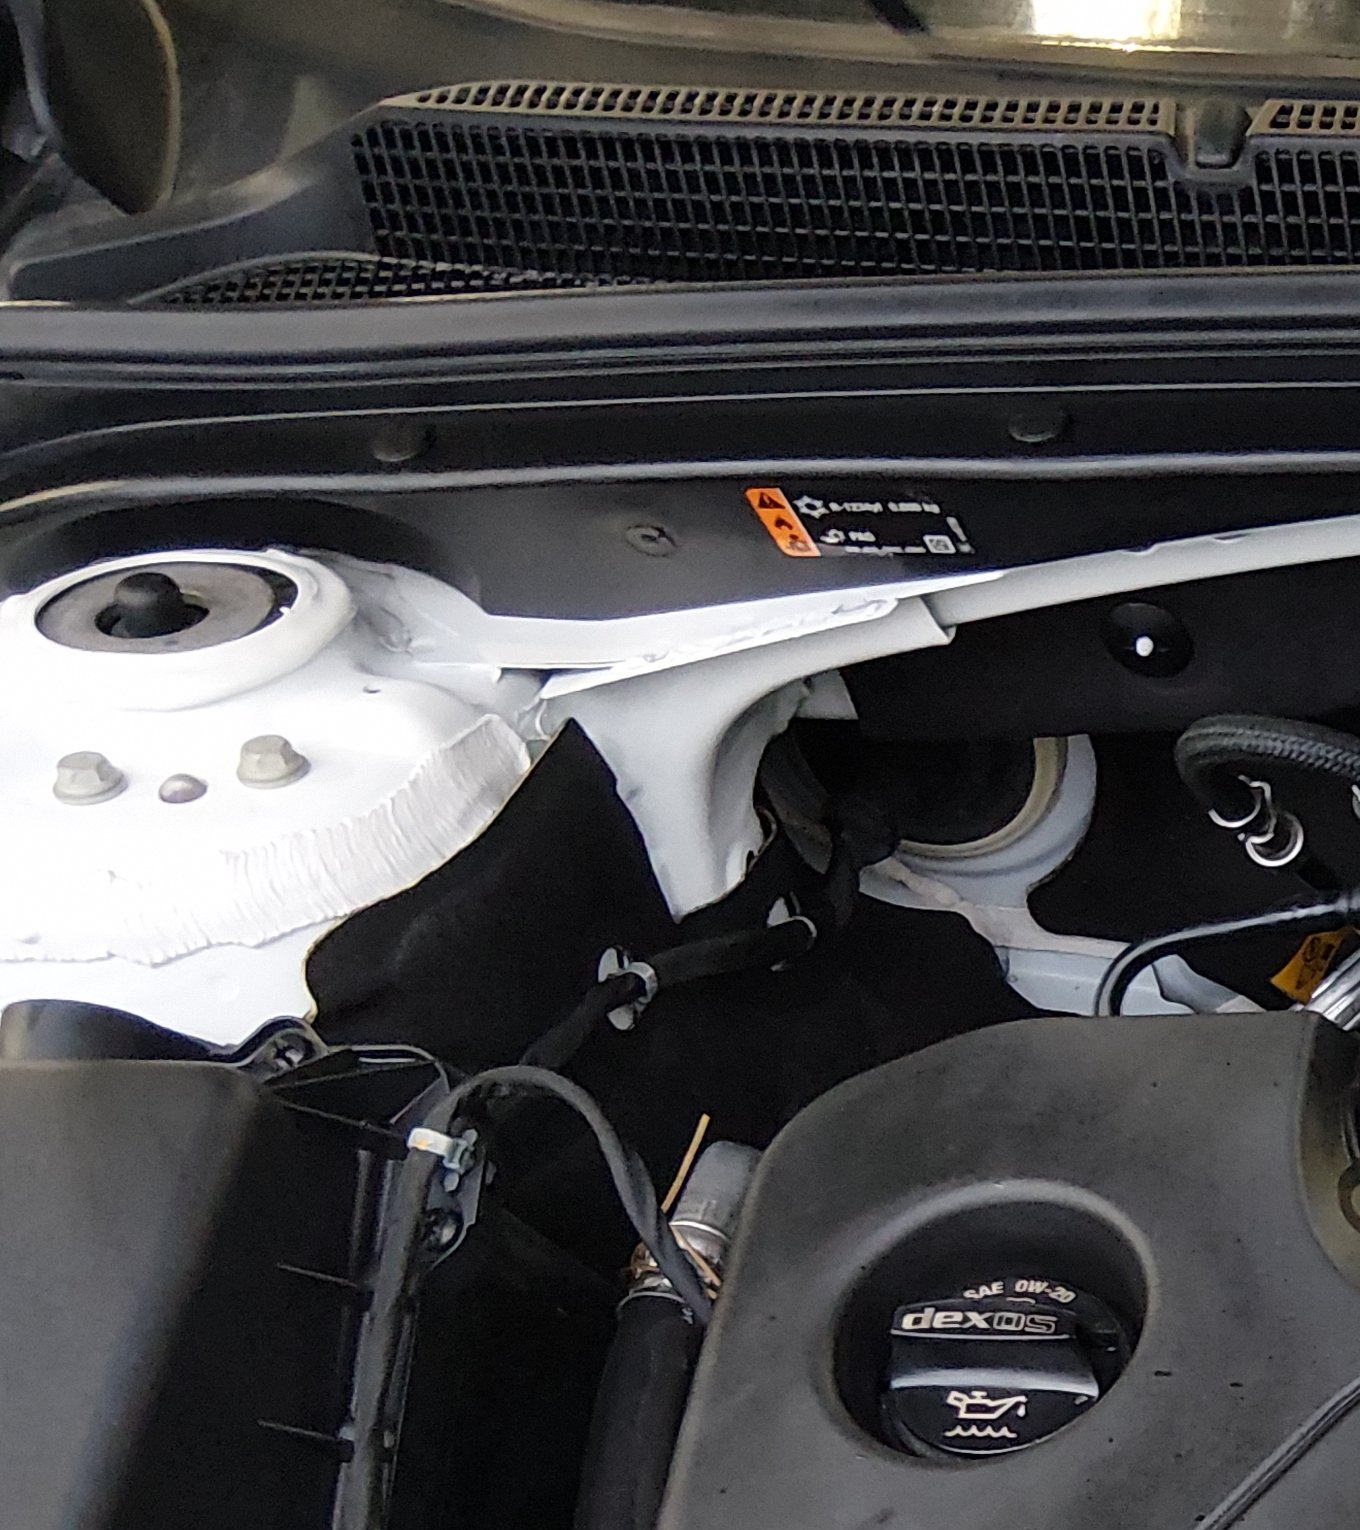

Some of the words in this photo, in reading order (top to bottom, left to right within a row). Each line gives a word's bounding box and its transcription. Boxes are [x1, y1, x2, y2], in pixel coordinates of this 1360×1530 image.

[962, 1281, 1005, 1300] SAE
[1013, 1278, 1078, 1304] 0W-20
[900, 1306, 1059, 1334] dexos
